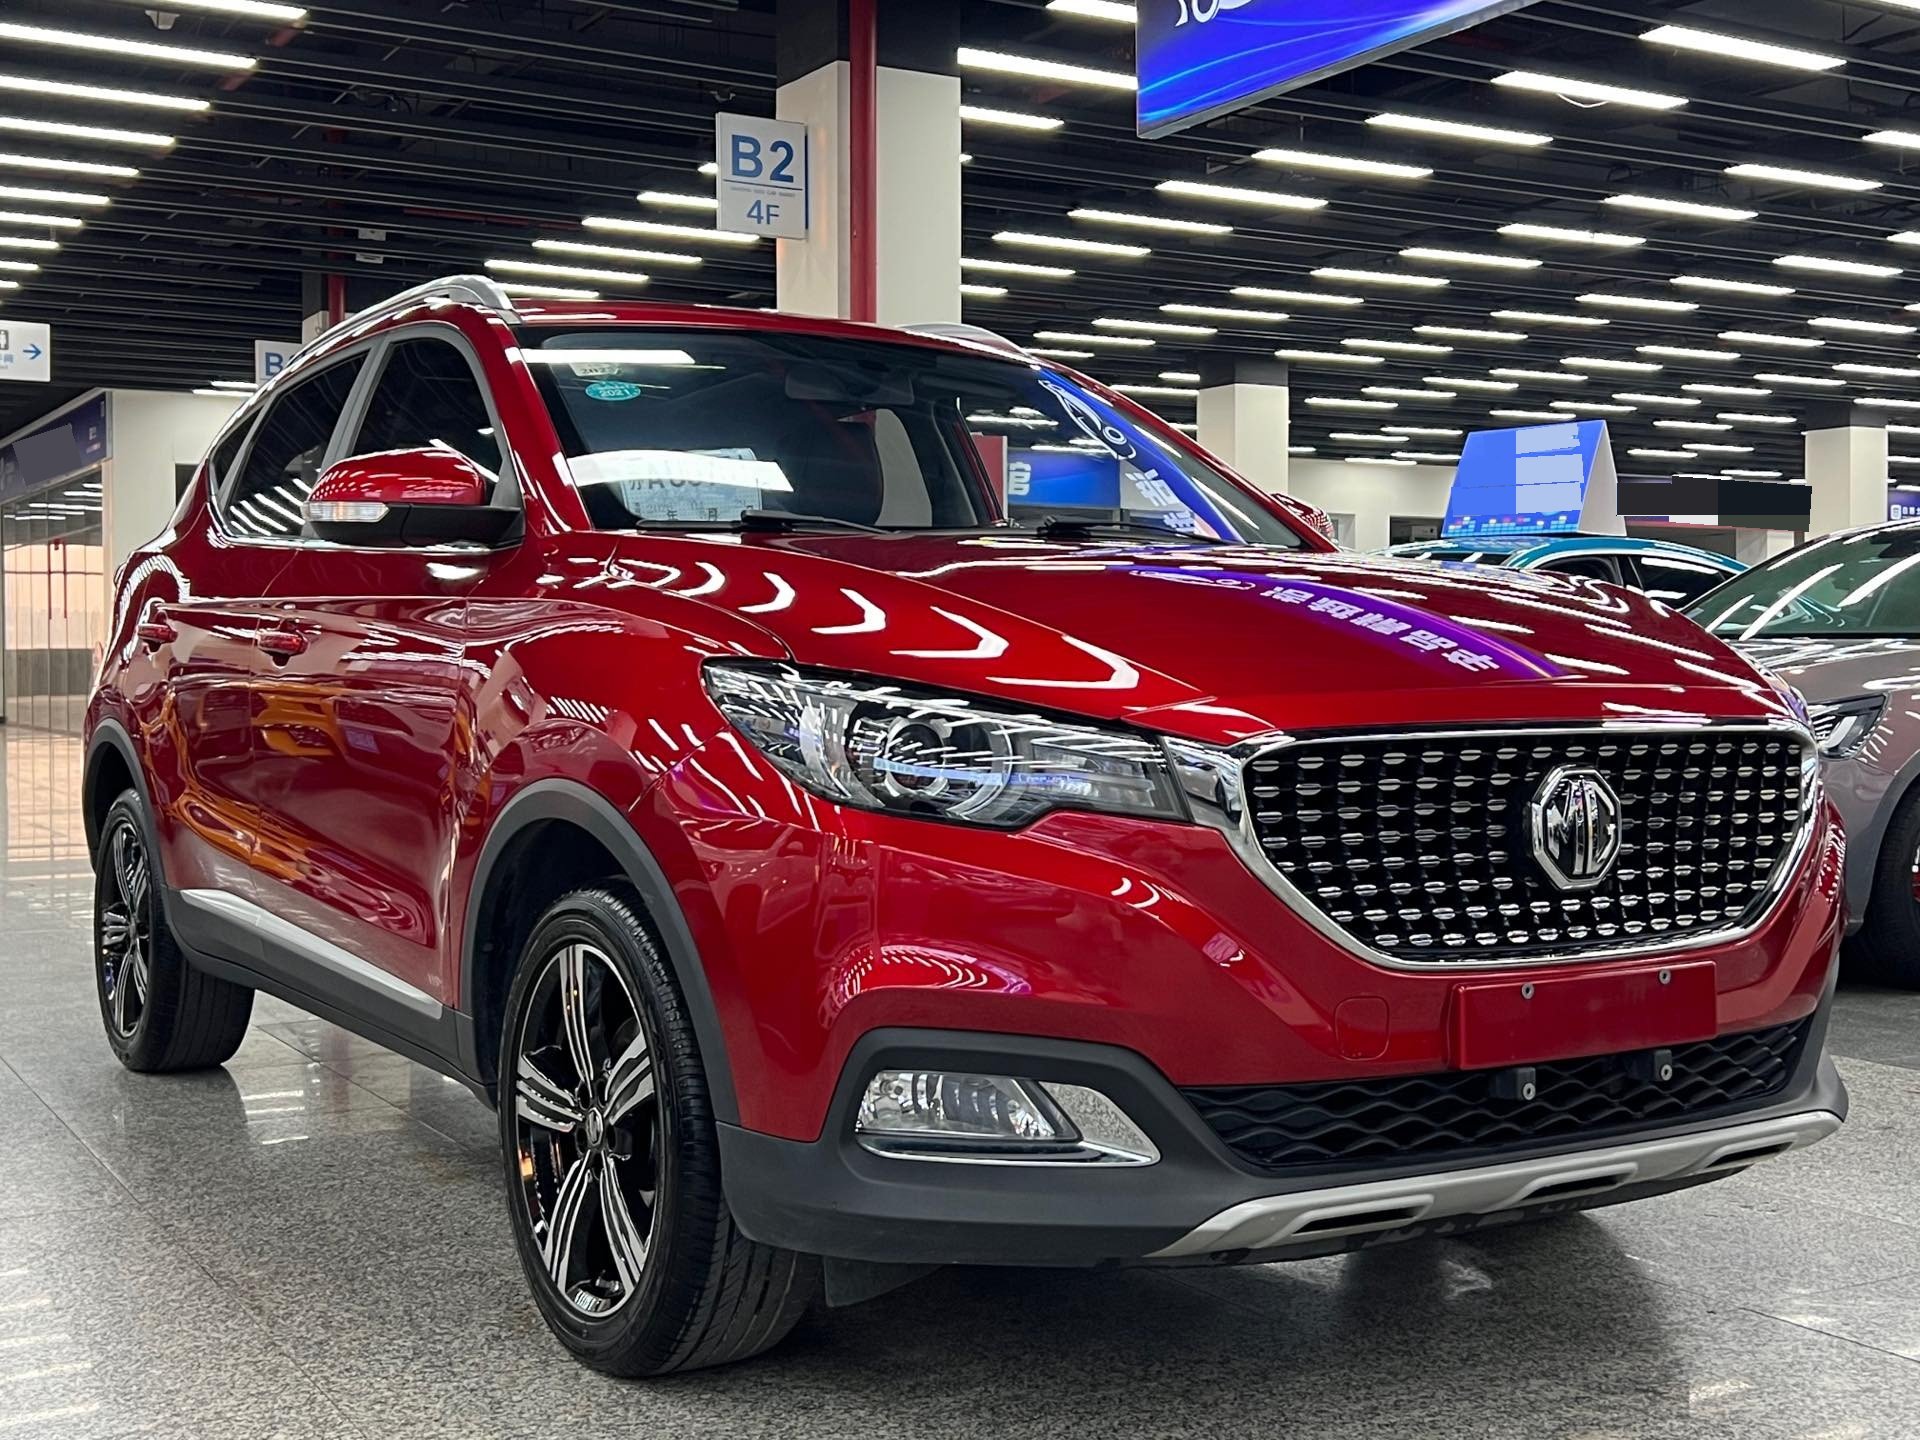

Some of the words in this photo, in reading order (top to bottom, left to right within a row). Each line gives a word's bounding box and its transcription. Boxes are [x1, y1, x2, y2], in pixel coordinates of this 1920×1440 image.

[731, 133, 794, 183] B2
[746, 199, 780, 225] 4F
[265, 351, 296, 377] B
[1545, 776, 1617, 876] MG
